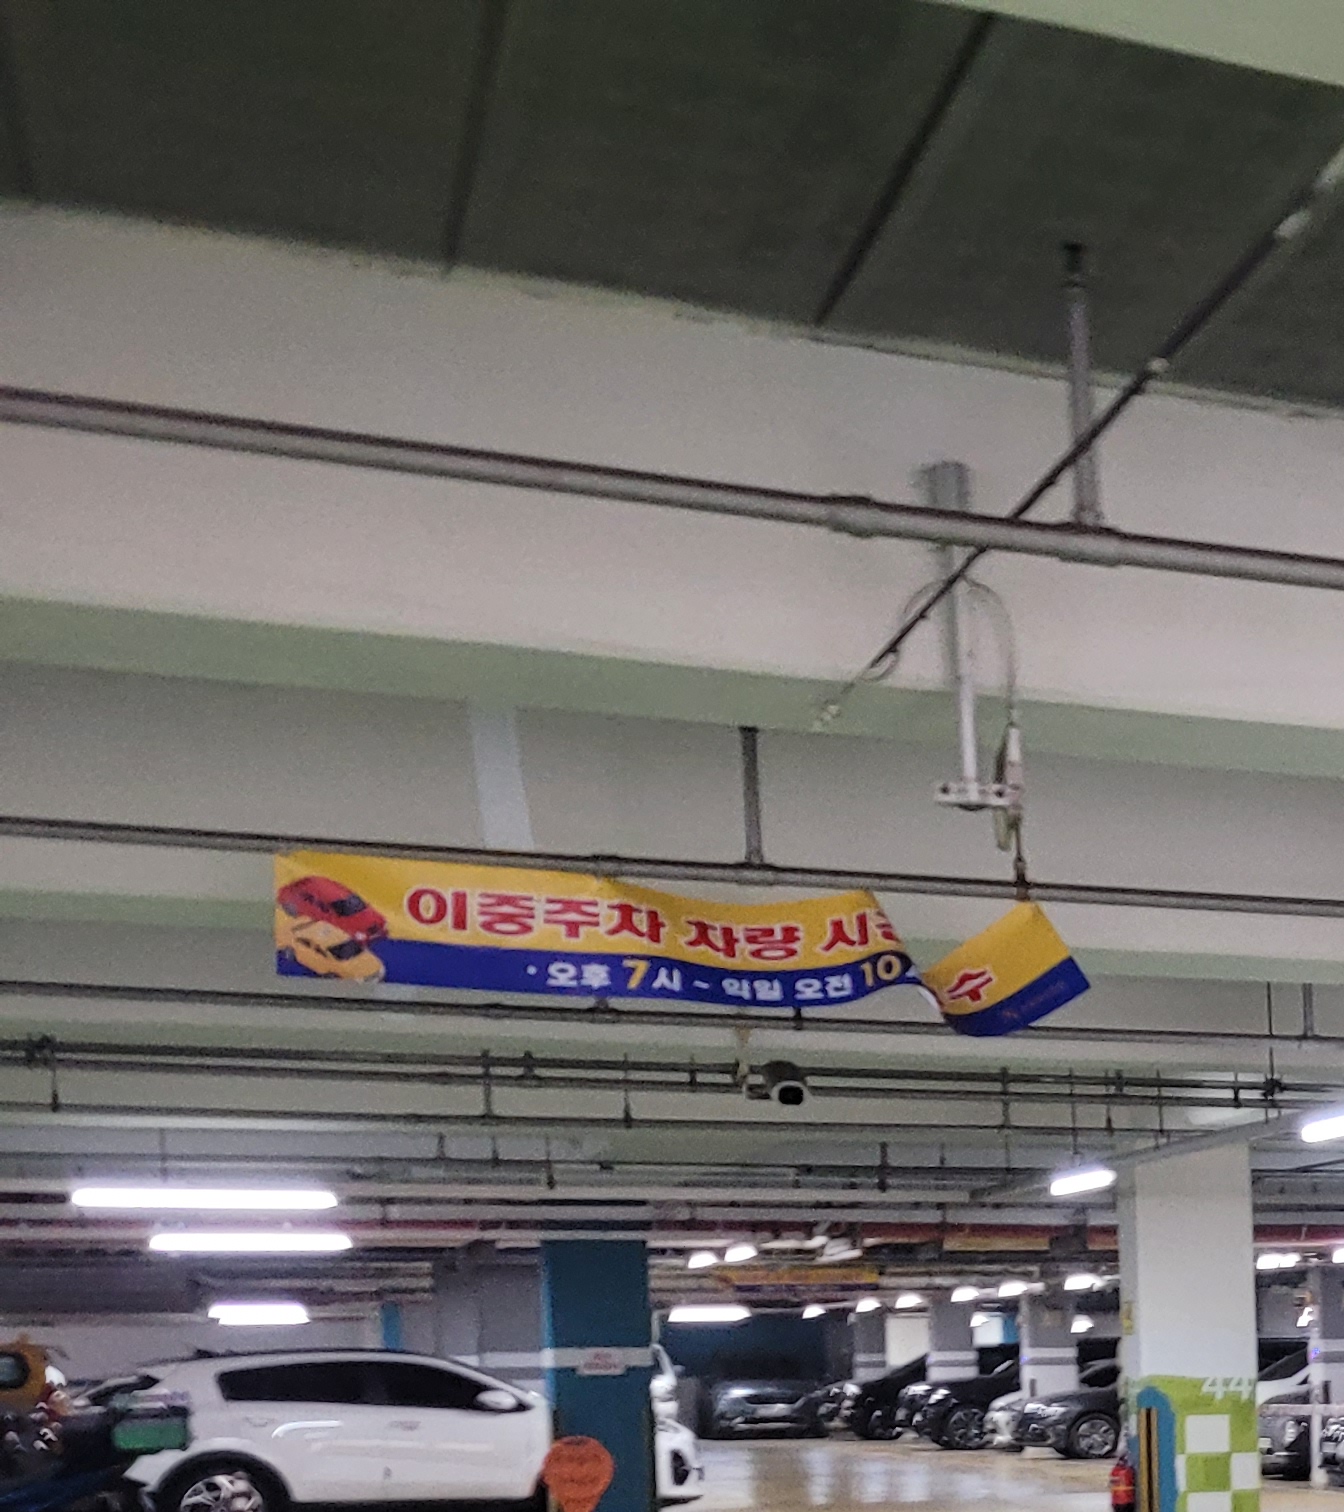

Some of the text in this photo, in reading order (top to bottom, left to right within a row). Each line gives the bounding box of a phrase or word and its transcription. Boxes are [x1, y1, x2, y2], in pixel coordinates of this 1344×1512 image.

[407, 888, 666, 943] 이중주차
[685, 919, 802, 960] 차량
[546, 961, 612, 989] 오후
[721, 977, 784, 1001] 익일
[794, 974, 854, 998] 오전
[1199, 1376, 1254, 1402] 44
